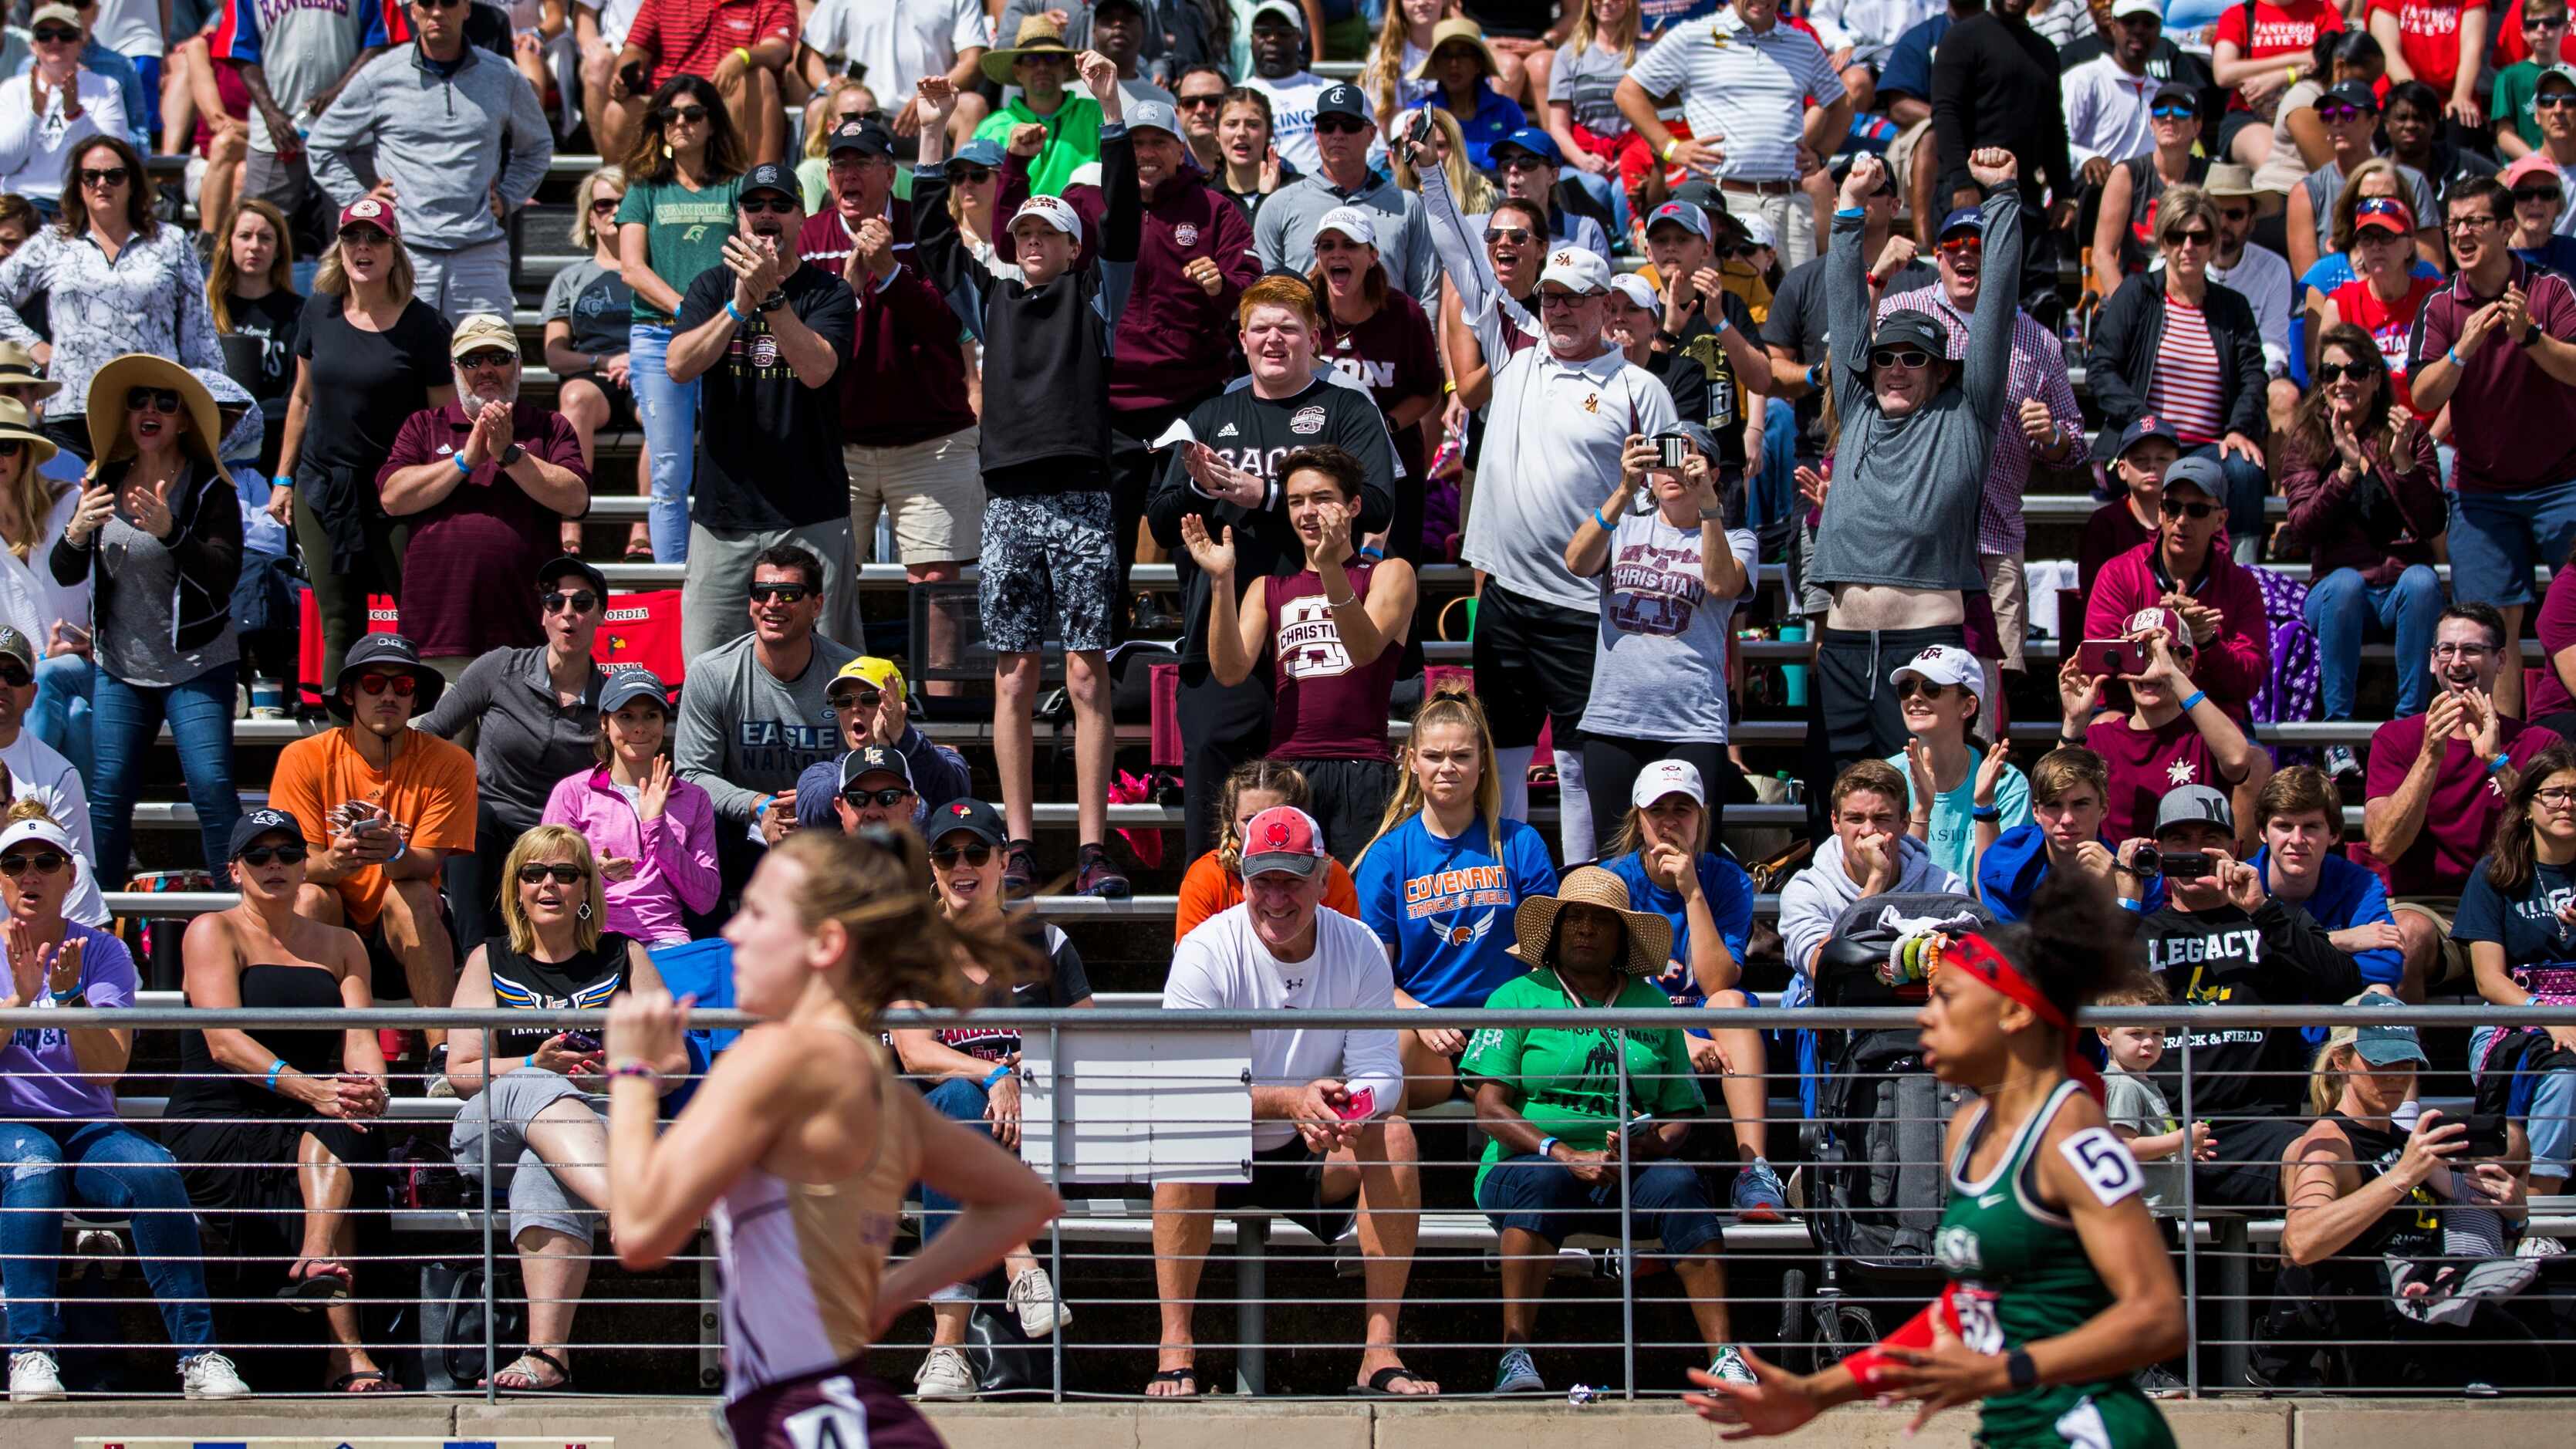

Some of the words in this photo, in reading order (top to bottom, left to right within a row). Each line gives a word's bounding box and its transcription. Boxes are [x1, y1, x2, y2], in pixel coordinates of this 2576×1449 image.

[1271, 109, 1315, 128] ING
[1555, 252, 1574, 266] SA
[1217, 445, 1307, 478] SAC
[370, 610, 399, 620] COR
[1280, 623, 1339, 650] CHRISTI
[743, 723, 836, 749] EAGLE
[1404, 865, 1507, 903] COVENANT
[1407, 897, 1454, 920] TRACK
[1457, 891, 1470, 906] &
[1474, 890, 1511, 904] FIELD
[2148, 929, 2261, 973] LEGACY
[937, 1028, 1021, 1046] ARDINA
[1600, 1027, 1660, 1044] ORMAN
[2209, 1032, 2222, 1045] &
[2222, 1030, 2264, 1043] FIELD
[2075, 1136, 2129, 1189] 5
